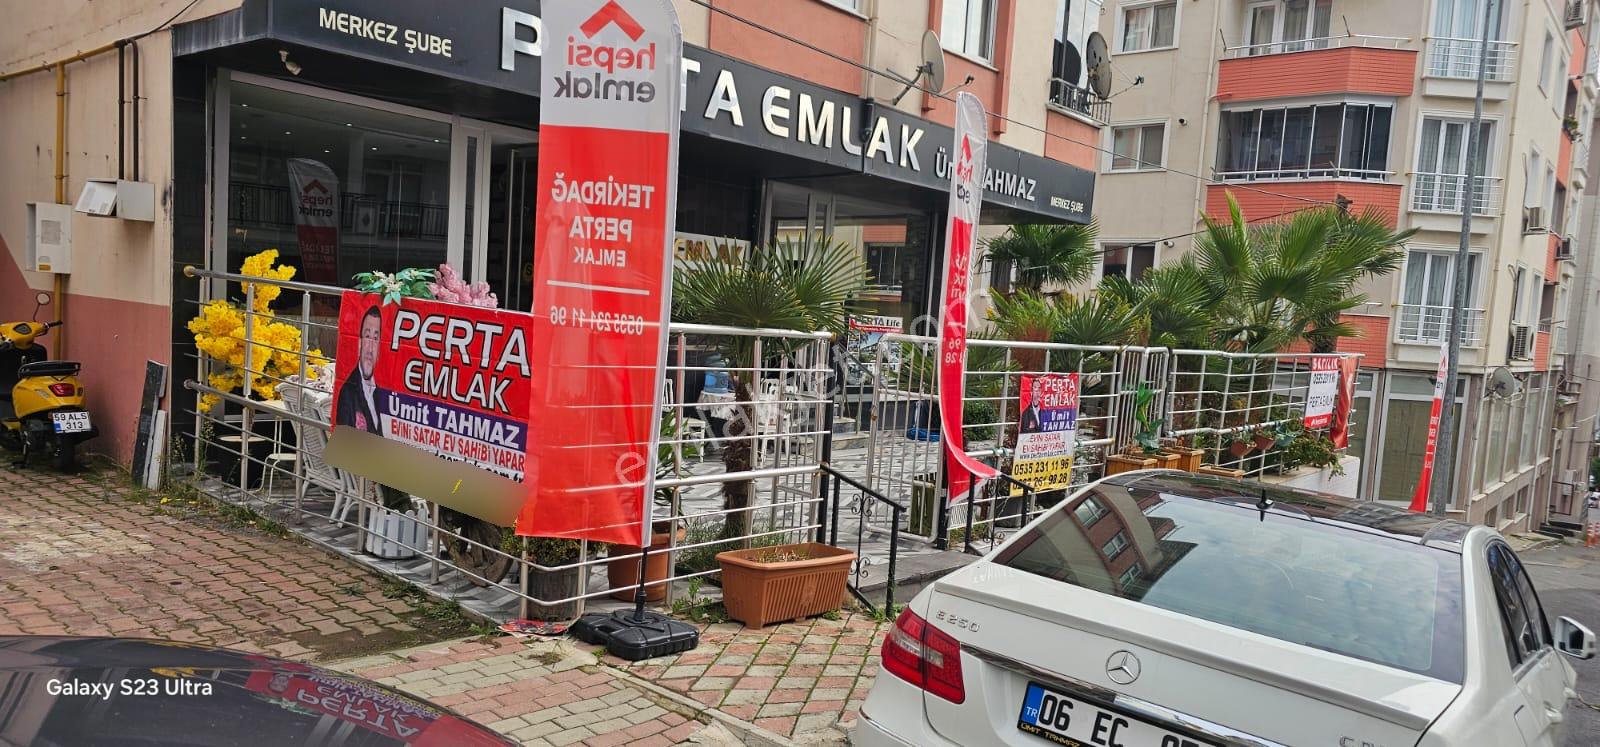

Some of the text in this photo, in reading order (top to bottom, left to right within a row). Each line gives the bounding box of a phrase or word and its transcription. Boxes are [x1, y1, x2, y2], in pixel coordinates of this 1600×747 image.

[319, 7, 452, 58] MERKEZ ŞUBE
[761, 84, 925, 172] EMLAK
[982, 167, 1036, 202] AHMAZ
[1050, 195, 1084, 214] MERKEZ ŞUBE
[886, 319, 900, 328] Life
[389, 309, 532, 378] PERTA
[403, 358, 514, 414] EMLAK
[1044, 378, 1076, 393] PERTA
[1044, 392, 1075, 407] EMLAK
[65, 421, 83, 430] 313
[68, 412, 88, 421] ALS
[388, 391, 520, 449] Ümit TAHMAZ
[1043, 420, 1076, 432] TAHMAZ
[413, 426, 441, 448] SATAR
[443, 432, 456, 453] EV
[492, 447, 525, 472] YAPAR
[1014, 458, 1070, 476] 0535 231 11 96
[1026, 706, 1038, 718] TR
[1038, 694, 1129, 747] 06 EC
